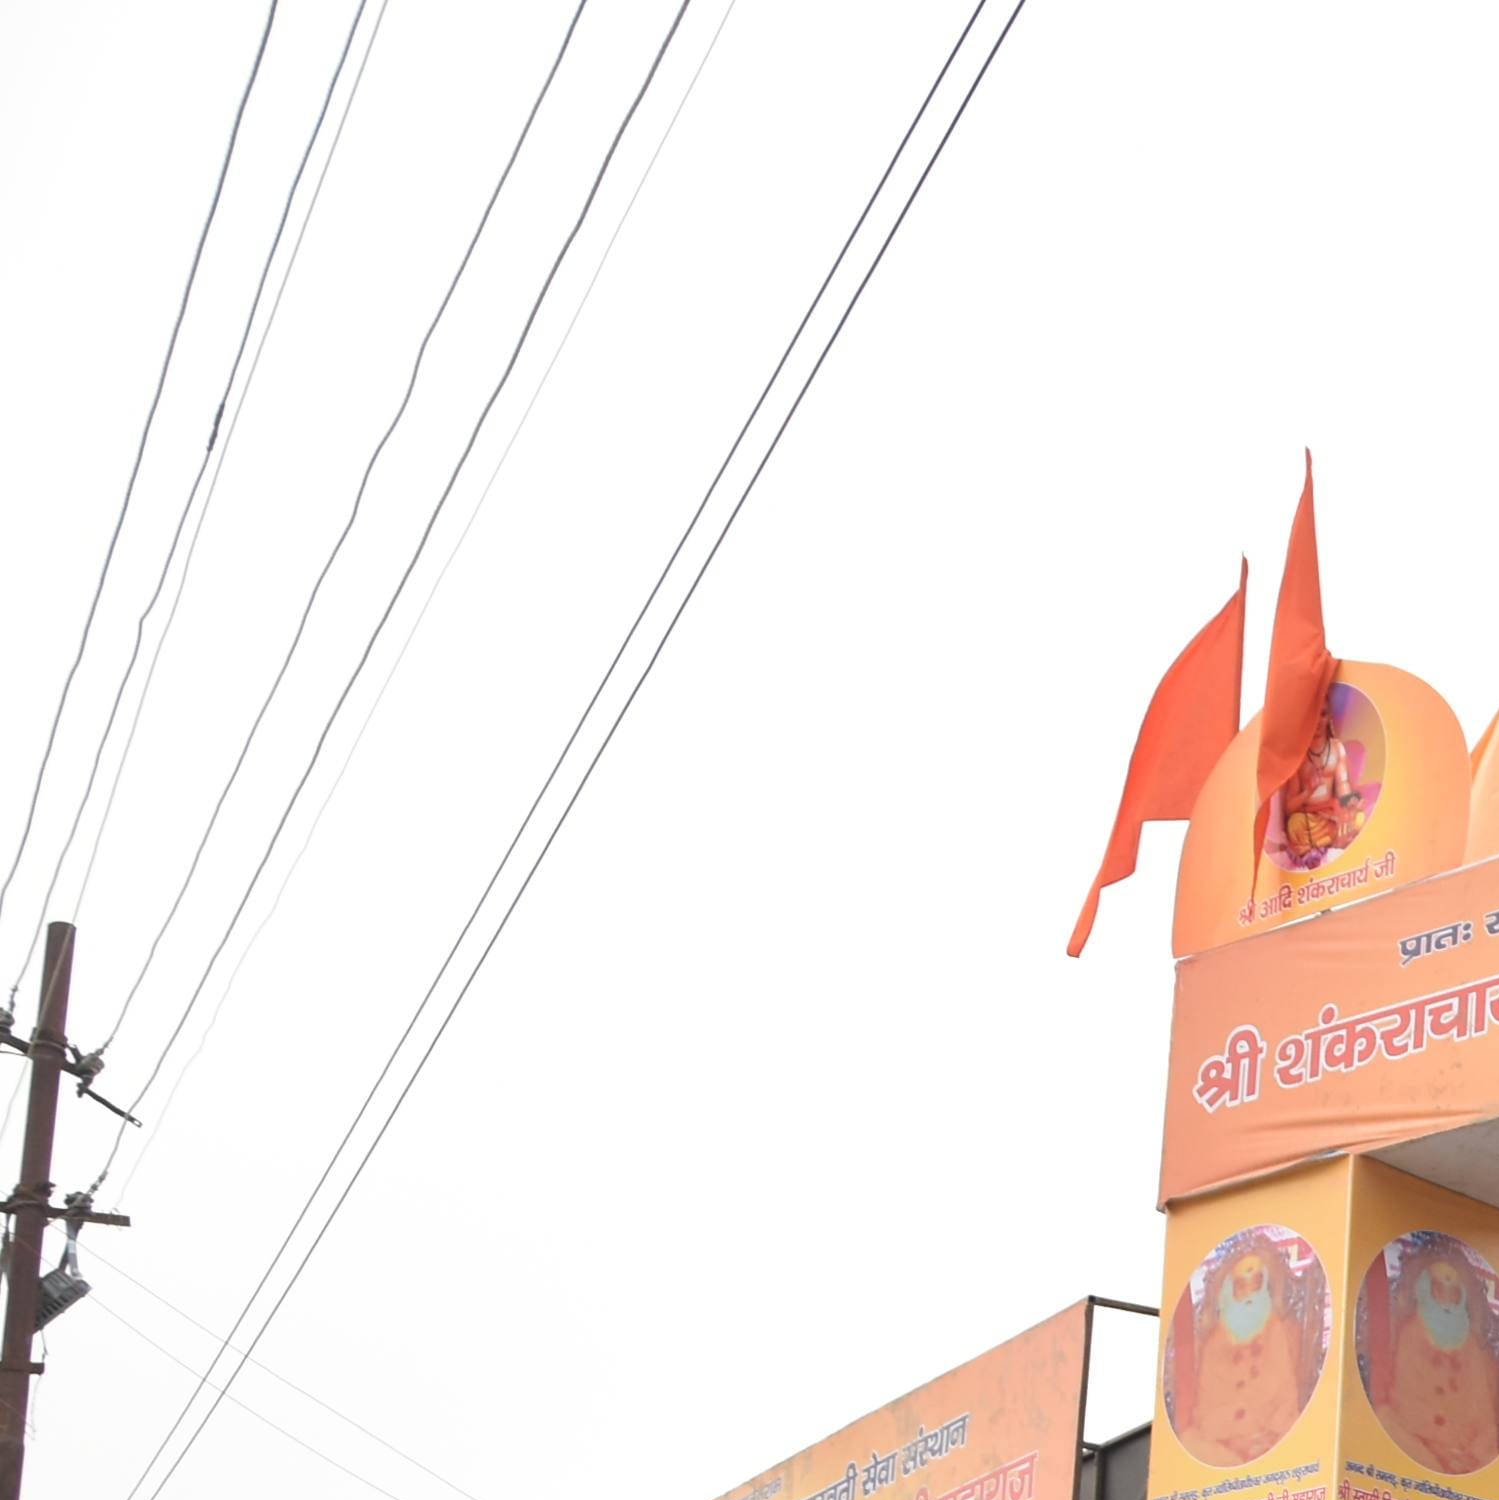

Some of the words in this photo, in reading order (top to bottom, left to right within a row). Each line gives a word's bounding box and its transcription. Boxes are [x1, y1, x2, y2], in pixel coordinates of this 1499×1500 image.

[1260, 884, 1293, 918] आदि
[1297, 859, 1370, 905] शंकराचार्य
[1374, 850, 1396, 880] जी
[1400, 921, 1473, 966] प्रातः
[1194, 1022, 1264, 1113] श्री
[862, 1452, 898, 1496] सेवा
